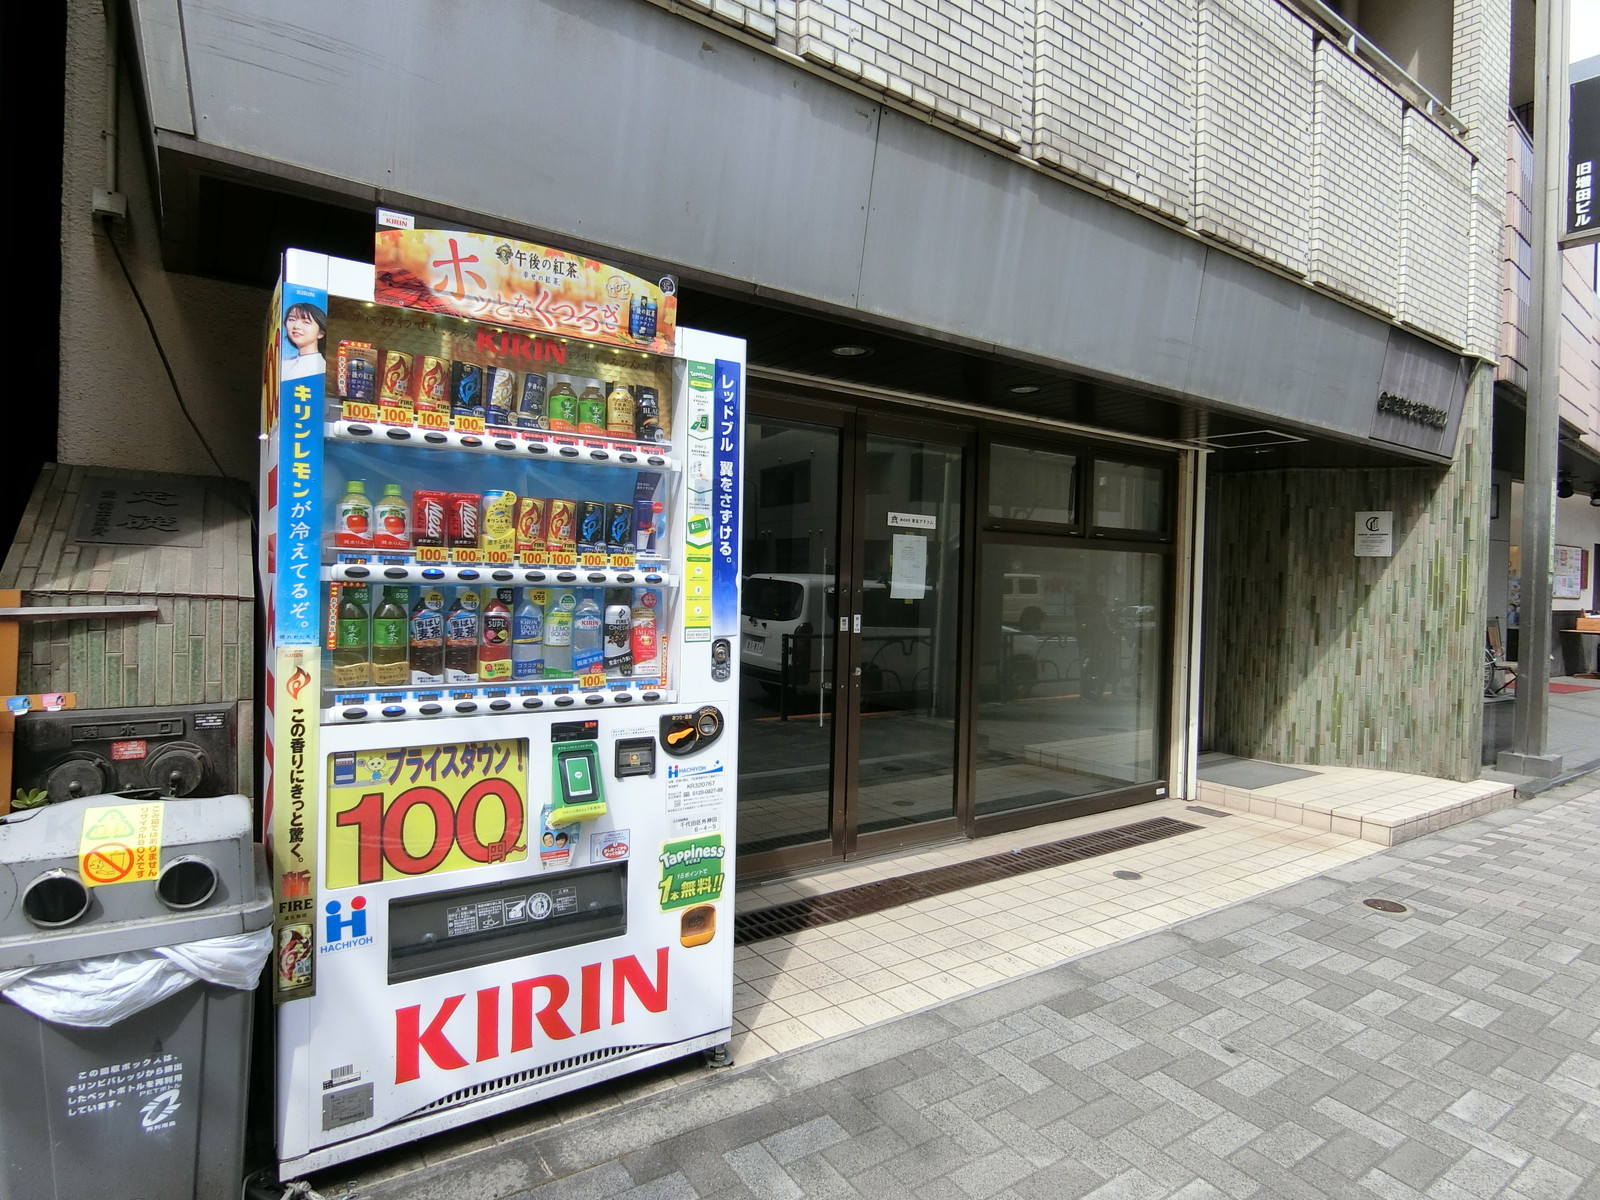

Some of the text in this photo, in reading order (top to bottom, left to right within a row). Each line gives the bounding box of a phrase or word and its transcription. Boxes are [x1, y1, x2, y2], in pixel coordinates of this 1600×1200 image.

[1574, 160, 1592, 227] 旧増田ビル
[386, 217, 408, 228] KIRIN
[514, 250, 578, 279] 午後の紅茶
[432, 238, 621, 332] ホッとなくつろぎ
[609, 282, 628, 294] HOT
[476, 327, 566, 365] KIRIN
[346, 404, 377, 420] 100円
[383, 407, 412, 424] 100円
[563, 401, 574, 419] 生茶
[591, 405, 602, 424] 生茶
[421, 412, 449, 428] 100円
[457, 417, 484, 432] 100円
[719, 374, 734, 564] レッドブル 翼をさずける。
[288, 384, 312, 629] キリンレモンが冷えてるぞ。
[427, 500, 444, 539] Mets
[462, 501, 478, 539] Mets
[419, 548, 446, 561] 100円
[455, 550, 482, 562] 100円
[487, 551, 513, 564] 100円
[522, 552, 547, 565] 100円
[552, 553, 576, 566] 100円
[583, 554, 606, 566] 100円
[612, 555, 635, 567] 100円
[347, 625, 360, 644] 生茶
[388, 624, 399, 643] 生茶
[582, 675, 605, 686] 100円
[386, 739, 525, 786] プライスダウン!
[678, 765, 707, 774] HACHIYOH
[288, 707, 306, 863] この香りにきっと驚く。
[136, 806, 149, 879] リサイクルBOXです
[148, 805, 160, 877] ごみ箱ではありません
[660, 844, 725, 869] Tappiness
[677, 868, 708, 880] 15ポイントで
[281, 870, 310, 898] 新
[659, 873, 725, 905] 1本無料!!
[278, 897, 314, 914] FIRE
[320, 936, 373, 954] HACHIYOH
[395, 946, 670, 1085] KIRIN
[78, 1054, 180, 1080] この回収ボックスは、
[67, 1074, 183, 1105] したペットボトルを再利用
[139, 1083, 182, 1097] PETボトル
[68, 1100, 123, 1117] しています。
